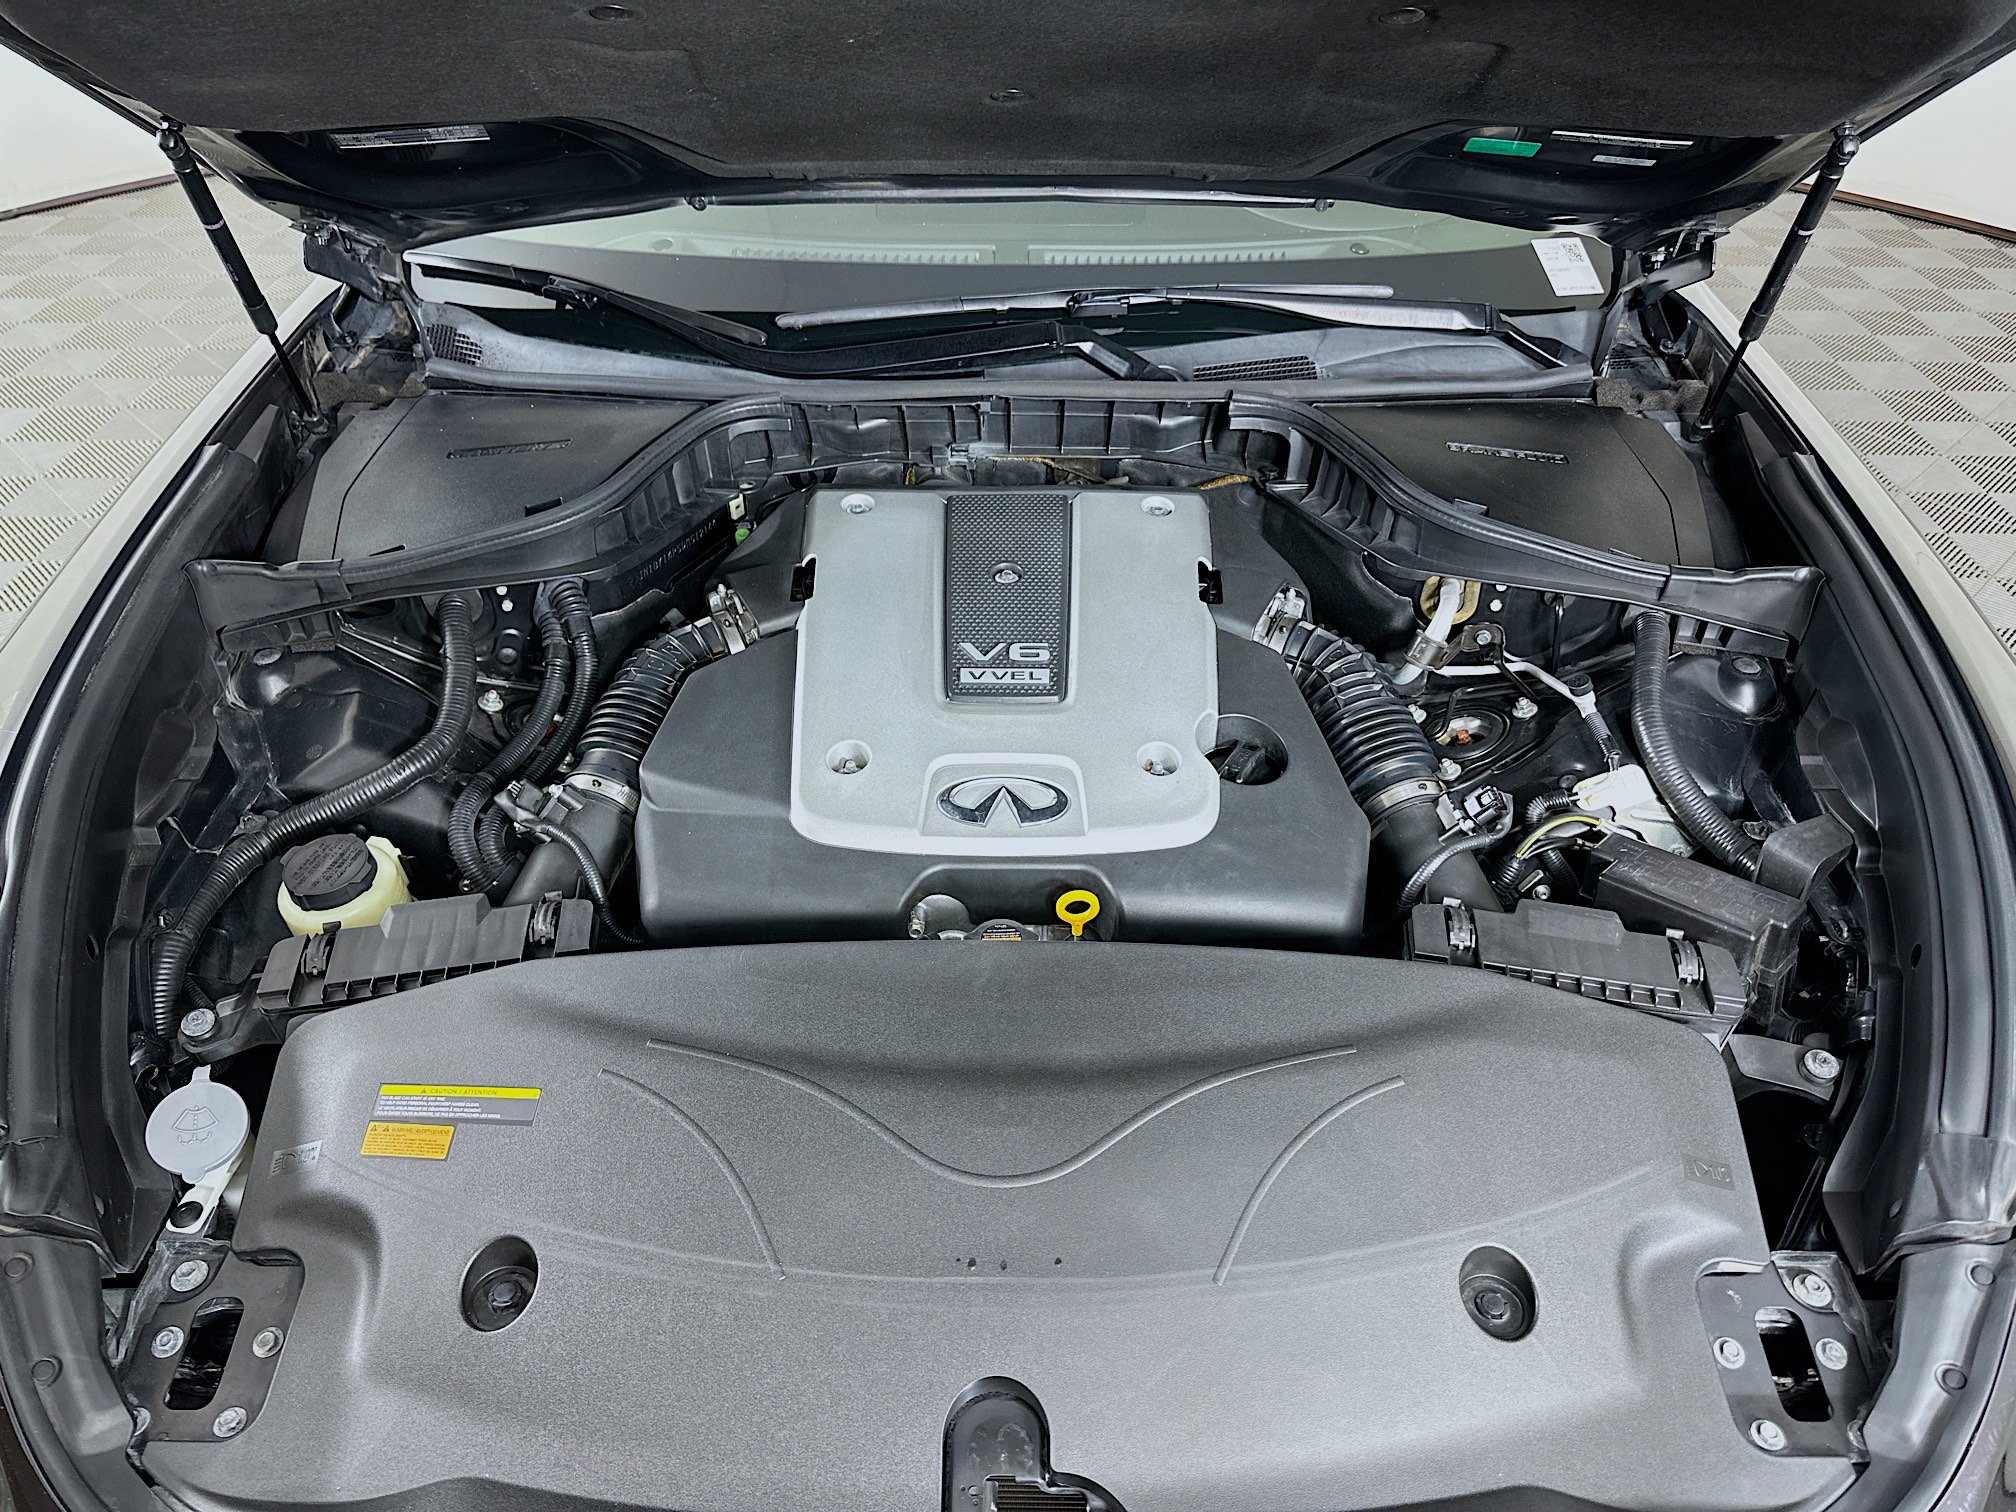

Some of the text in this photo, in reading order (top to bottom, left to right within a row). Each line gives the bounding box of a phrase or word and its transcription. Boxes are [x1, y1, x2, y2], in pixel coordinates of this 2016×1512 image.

[958, 642, 1051, 664] V6
[968, 670, 1043, 681] VVEL
[430, 1088, 458, 1096] CAUTION
